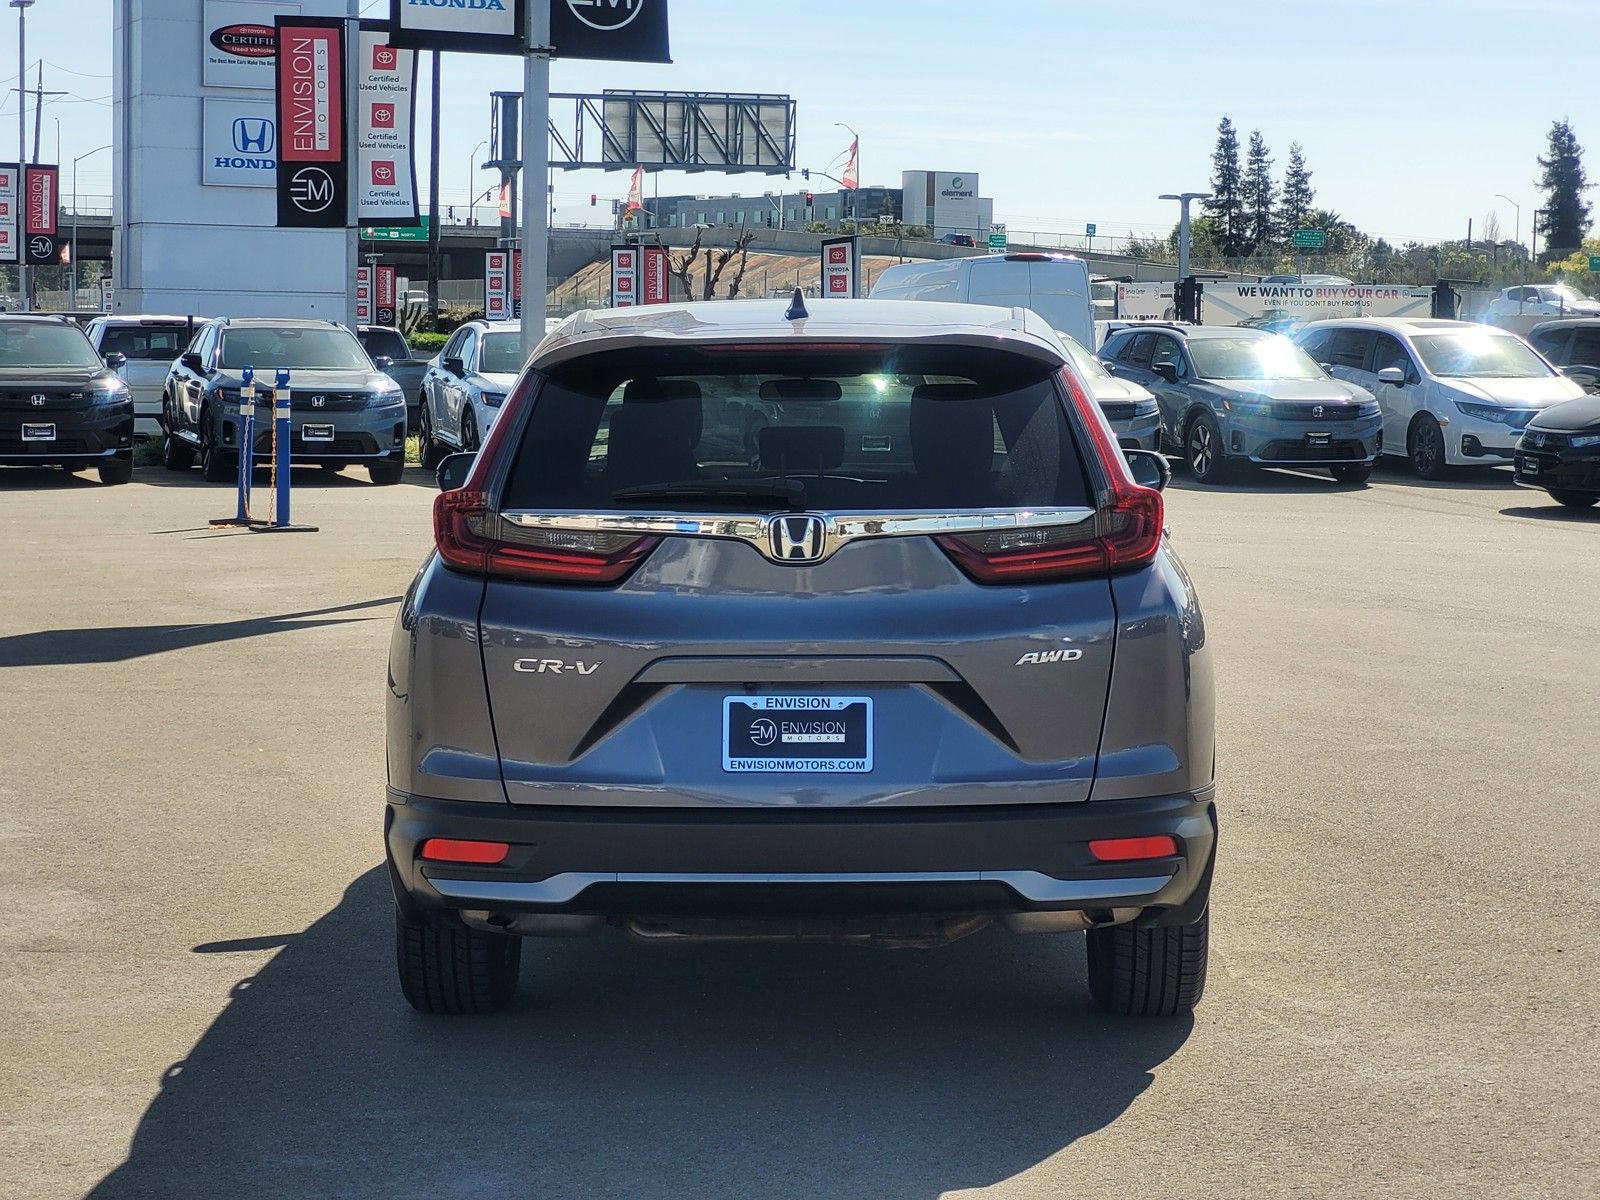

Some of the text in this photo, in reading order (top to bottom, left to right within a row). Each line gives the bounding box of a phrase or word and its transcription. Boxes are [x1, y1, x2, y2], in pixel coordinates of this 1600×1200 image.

[221, 34, 275, 46] CERTIFIE
[292, 38, 313, 150] ENVISION
[317, 48, 327, 141] MOTORS
[379, 84, 408, 92] Vehicles
[367, 133, 398, 142] Certified
[214, 157, 276, 170] HOND
[941, 188, 974, 198] element
[32, 174, 43, 229] ENVISION
[1238, 286, 1256, 296] WE
[1259, 287, 1296, 298] WANT
[1298, 288, 1314, 298] TO
[1316, 288, 1339, 298] BUY
[1340, 288, 1372, 298] YOUR
[1375, 289, 1398, 299] CAR
[1014, 648, 1082, 666] AWD
[513, 658, 604, 675] CR-V
[766, 698, 831, 709] ENVISION
[781, 721, 846, 734] ENVISION
[730, 760, 866, 770] ENVISIONMOTORS.COM
